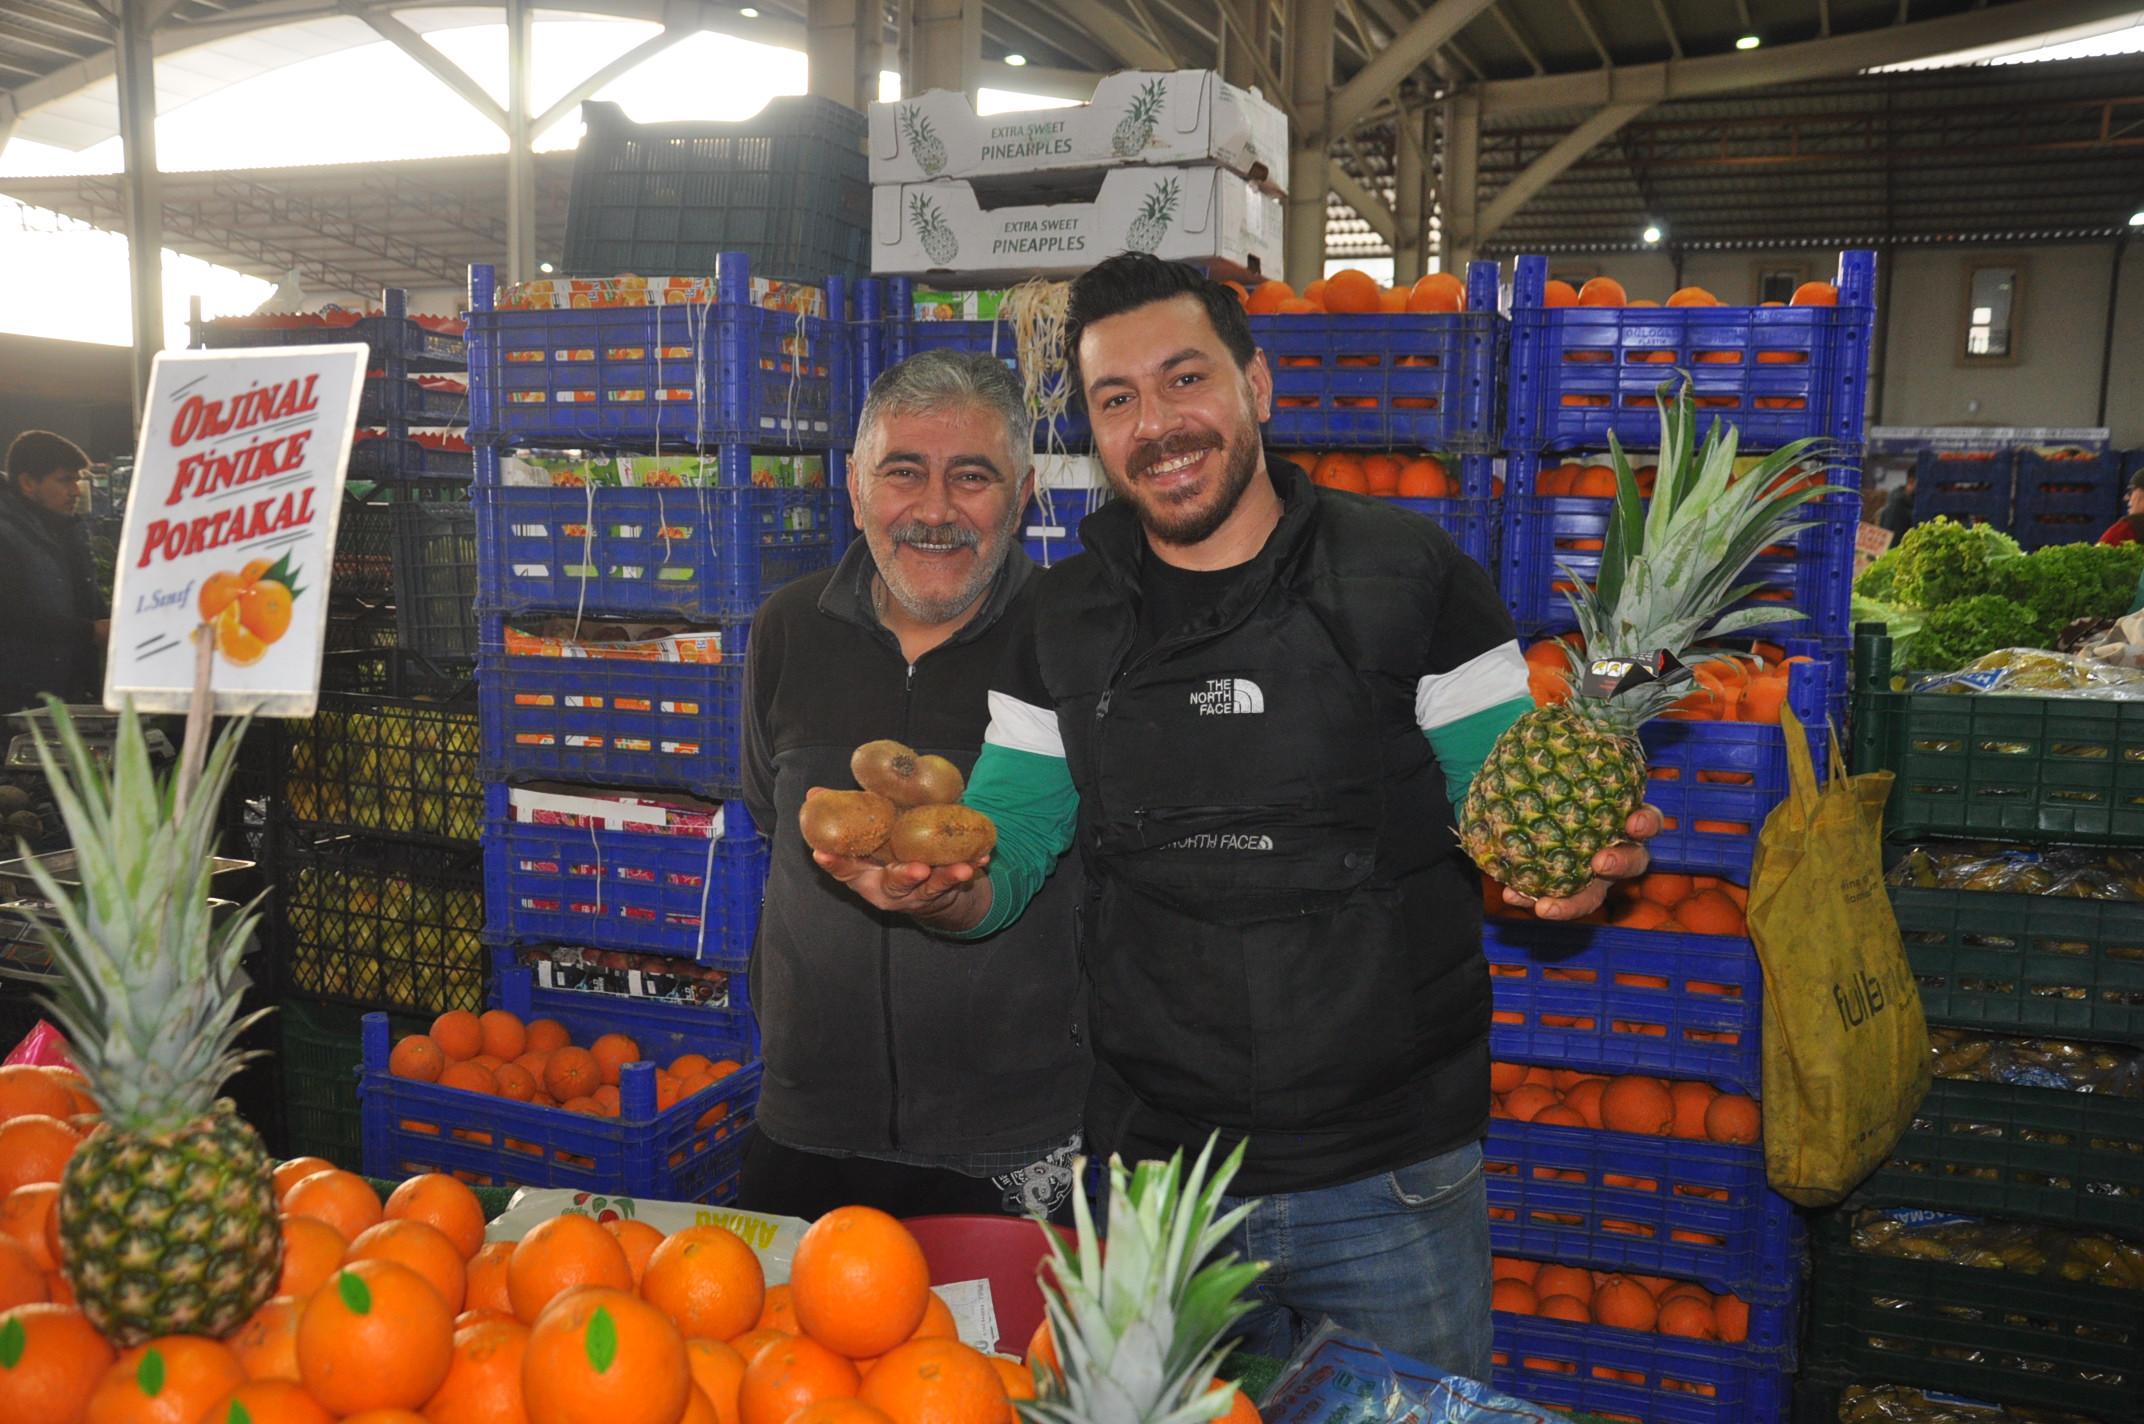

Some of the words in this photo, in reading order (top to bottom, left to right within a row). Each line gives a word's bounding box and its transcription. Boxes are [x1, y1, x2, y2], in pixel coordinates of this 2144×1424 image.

[991, 126, 1023, 139] EXTRA
[1027, 121, 1065, 136] SWEET
[981, 138, 1072, 160] PINEAPPLES
[1004, 220, 1039, 233] EXTRA
[1041, 218, 1079, 232] SWEET
[992, 235, 1086, 255] PINEAPPLES
[170, 373, 319, 447] ORJİNAL
[165, 429, 312, 506] FİNİKE
[137, 487, 316, 569] PORTAKAL
[1206, 678, 1232, 692] THE
[1189, 691, 1232, 705] NORTH
[1199, 703, 1232, 716] FACE
[1220, 834, 1259, 850] FACE
